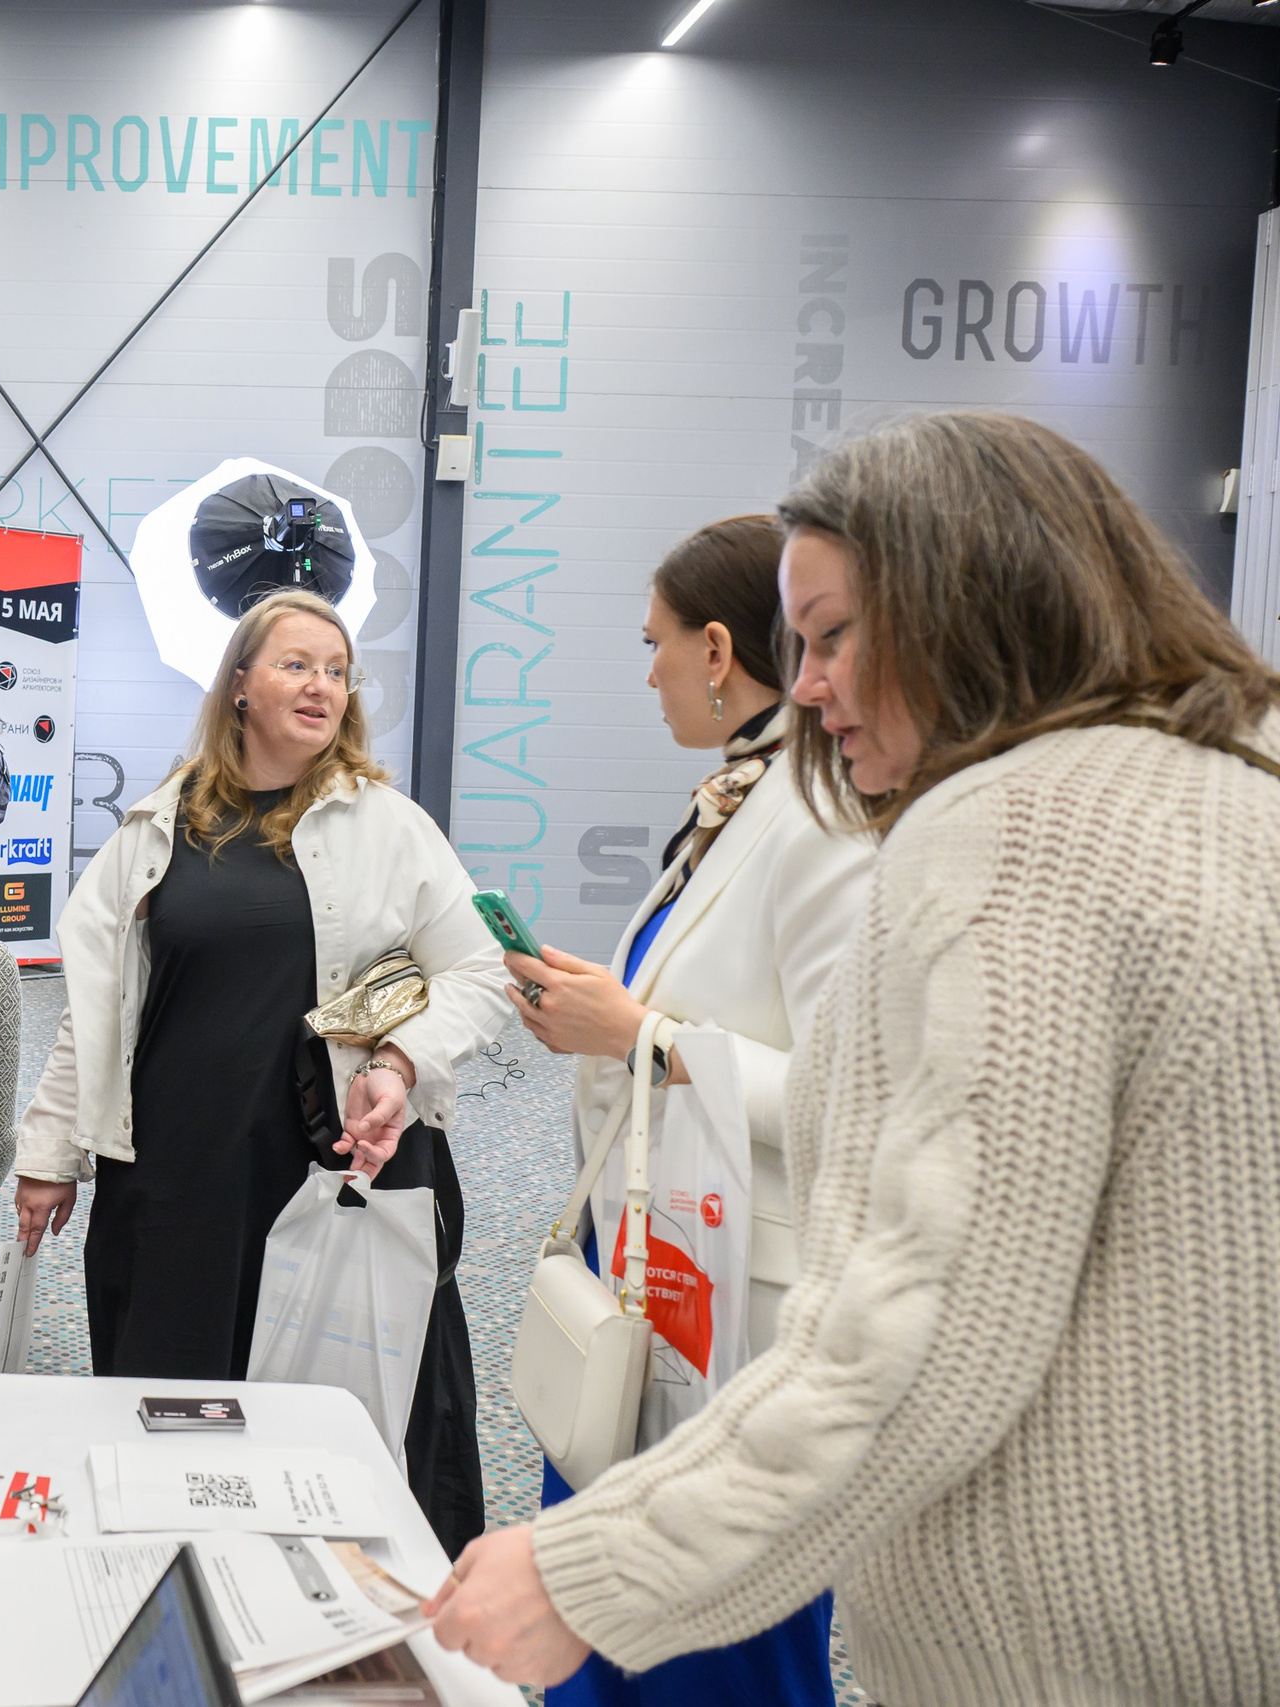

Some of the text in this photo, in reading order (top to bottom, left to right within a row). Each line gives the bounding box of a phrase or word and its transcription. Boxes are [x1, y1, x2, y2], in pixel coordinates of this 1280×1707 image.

[901, 278, 1210, 366] GROWTH
[790, 234, 851, 486] INCREA
[222, 544, 252, 563] YnBox
[19, 599, 63, 622] МАЯ
[458, 289, 570, 929] GUARANTEE
[21, 676, 58, 684] ДИЗАЙНЕРОВ
[22, 667, 41, 675] СОЮЗ
[21, 684, 62, 693] АРХИТЕКТОРОВ
[1, 724, 30, 735] РАНИ
[9, 774, 55, 812] NAUF
[0, 914, 27, 923] GROUP
